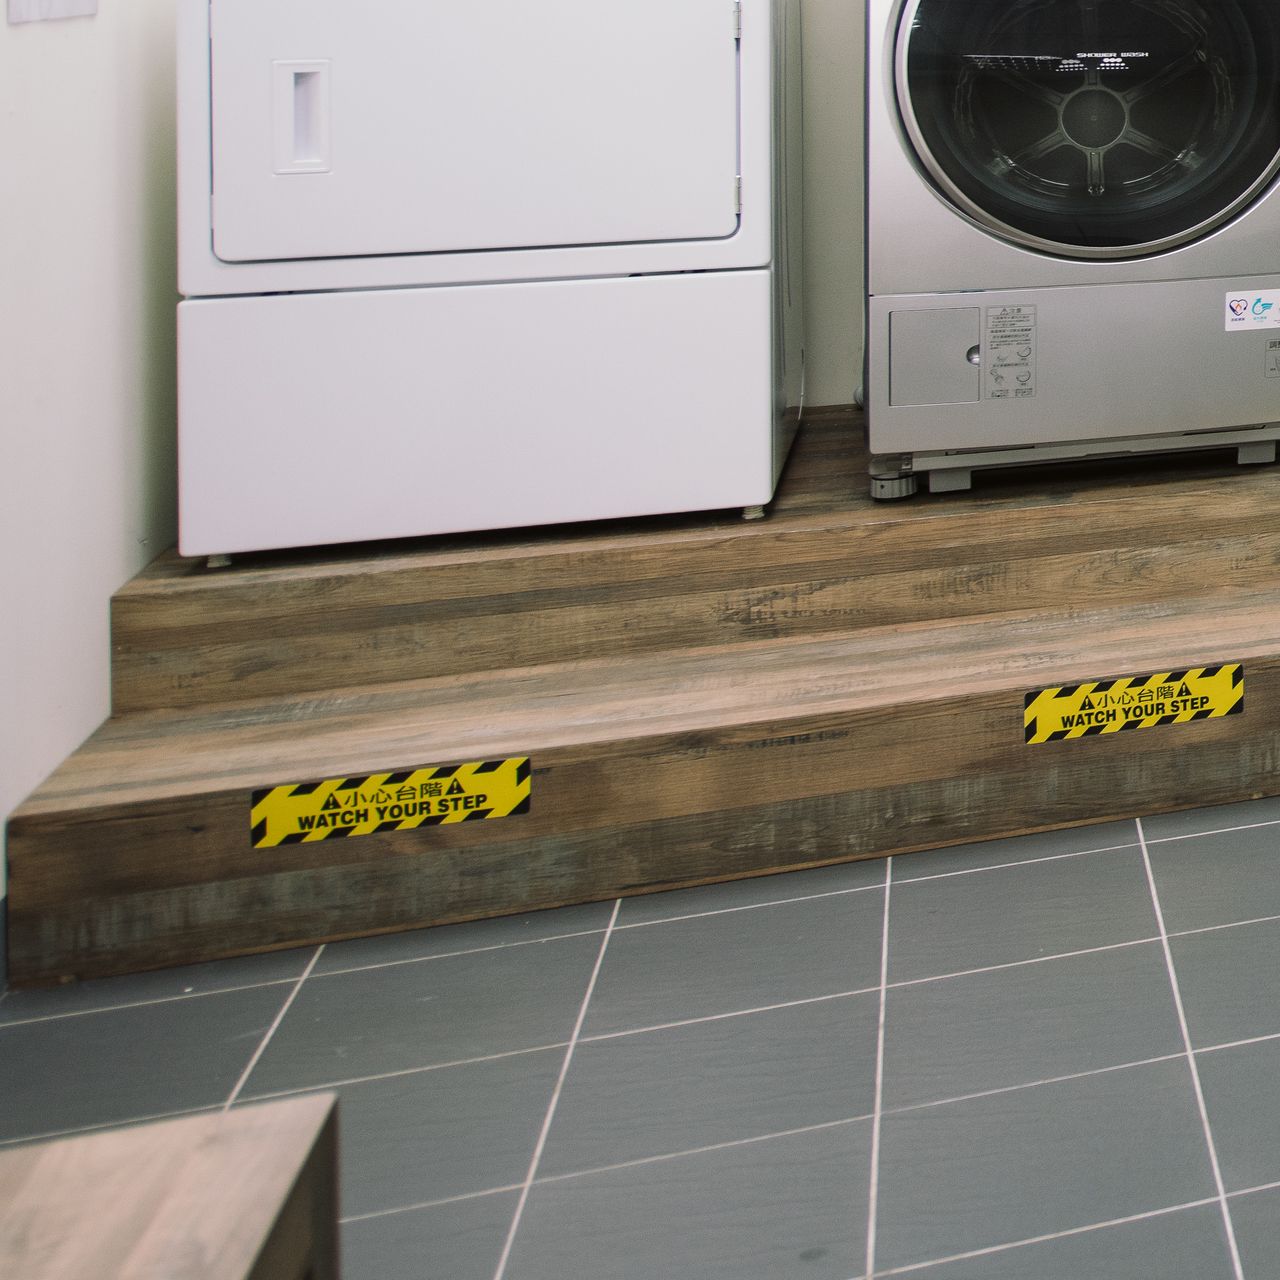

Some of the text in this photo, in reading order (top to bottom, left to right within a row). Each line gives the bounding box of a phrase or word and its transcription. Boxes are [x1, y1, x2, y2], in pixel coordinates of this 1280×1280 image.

[1060, 695, 1210, 729] WATCH YOUR STEP
[1097, 685, 1174, 709] 小心台階
[344, 782, 443, 808] 小心台階
[297, 793, 488, 831] WATCH YOUR STEP
